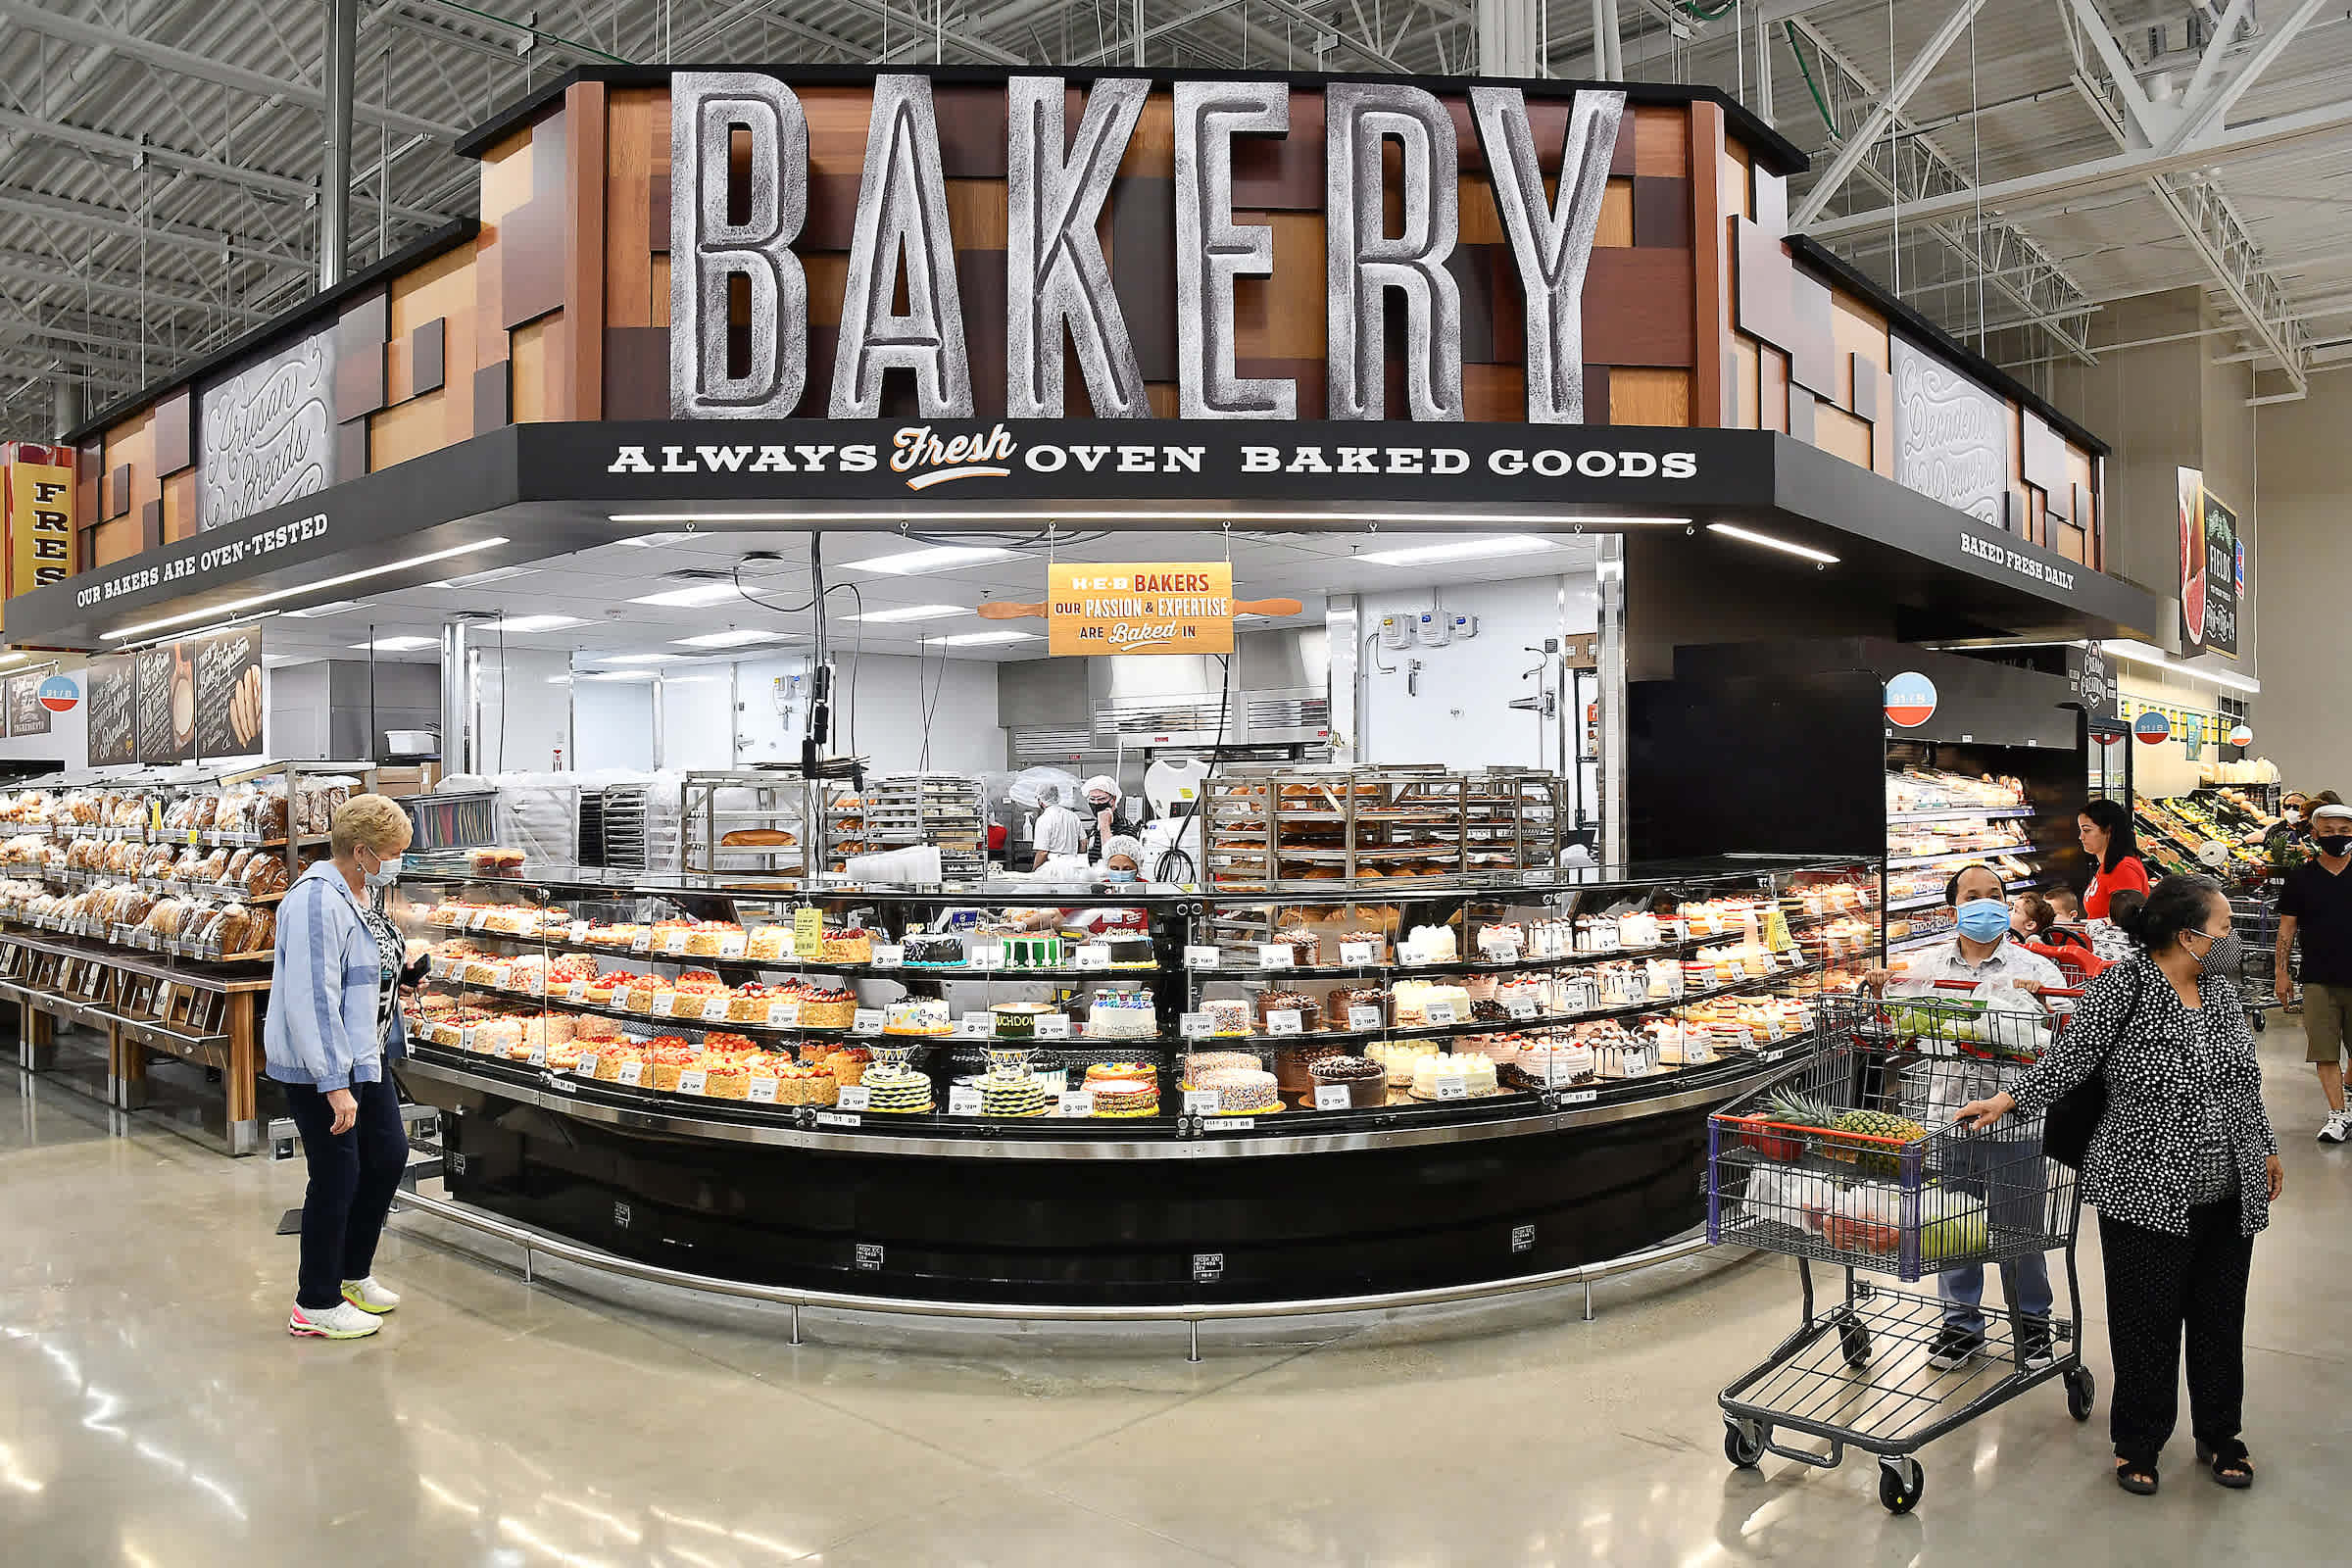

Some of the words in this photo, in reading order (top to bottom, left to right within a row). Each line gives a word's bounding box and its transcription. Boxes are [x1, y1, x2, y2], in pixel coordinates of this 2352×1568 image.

[670, 72, 1627, 423] BAKERY
[607, 444, 878, 473] ALWAYS
[889, 422, 1017, 472] Fresh
[1024, 445, 1206, 473] OVEN
[1241, 446, 1470, 473] BAKED
[1488, 449, 1697, 479] GOODS
[76, 585, 101, 609] OUR
[105, 566, 159, 600] BAKERS
[163, 556, 196, 582] ARE
[200, 513, 328, 572] OVEN-TESTED
[1960, 532, 2005, 565] BAKED
[2006, 549, 2043, 580] FRESH
[2044, 564, 2075, 591] DAILY
[2210, 544, 2231, 583] FIELDS
[1134, 573, 1209, 593] BAKERS
[1055, 602, 1081, 614] OUR
[1086, 598, 1143, 617] PASSION
[1145, 602, 1154, 614] &
[1157, 597, 1229, 617] EXPERTISE
[1080, 626, 1103, 639] ARE
[1107, 620, 1177, 644] Baked
[1182, 625, 1196, 638] IN
[996, 1014, 1036, 1028] UCHDO
